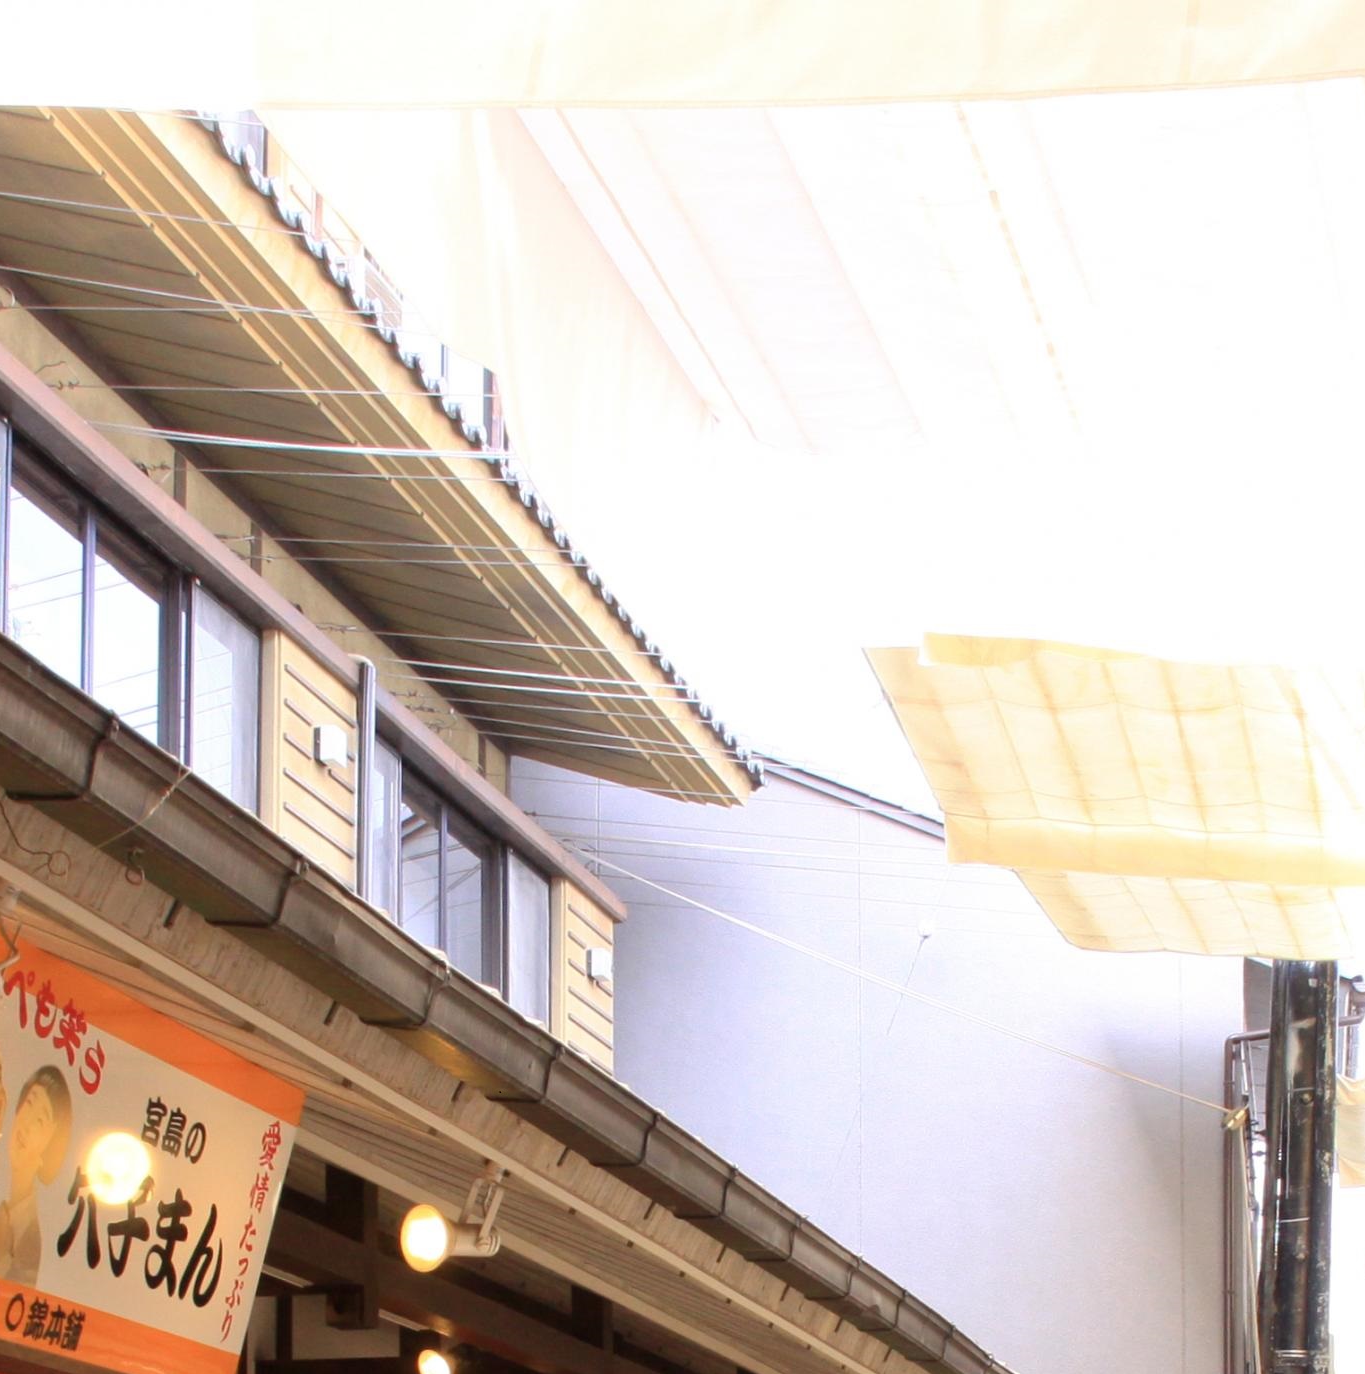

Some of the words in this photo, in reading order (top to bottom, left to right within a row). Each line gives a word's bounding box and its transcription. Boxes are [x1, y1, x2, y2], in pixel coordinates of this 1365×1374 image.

[141, 1097, 207, 1164] 宮島の
[220, 1121, 282, 1343] 愛情たっぷり
